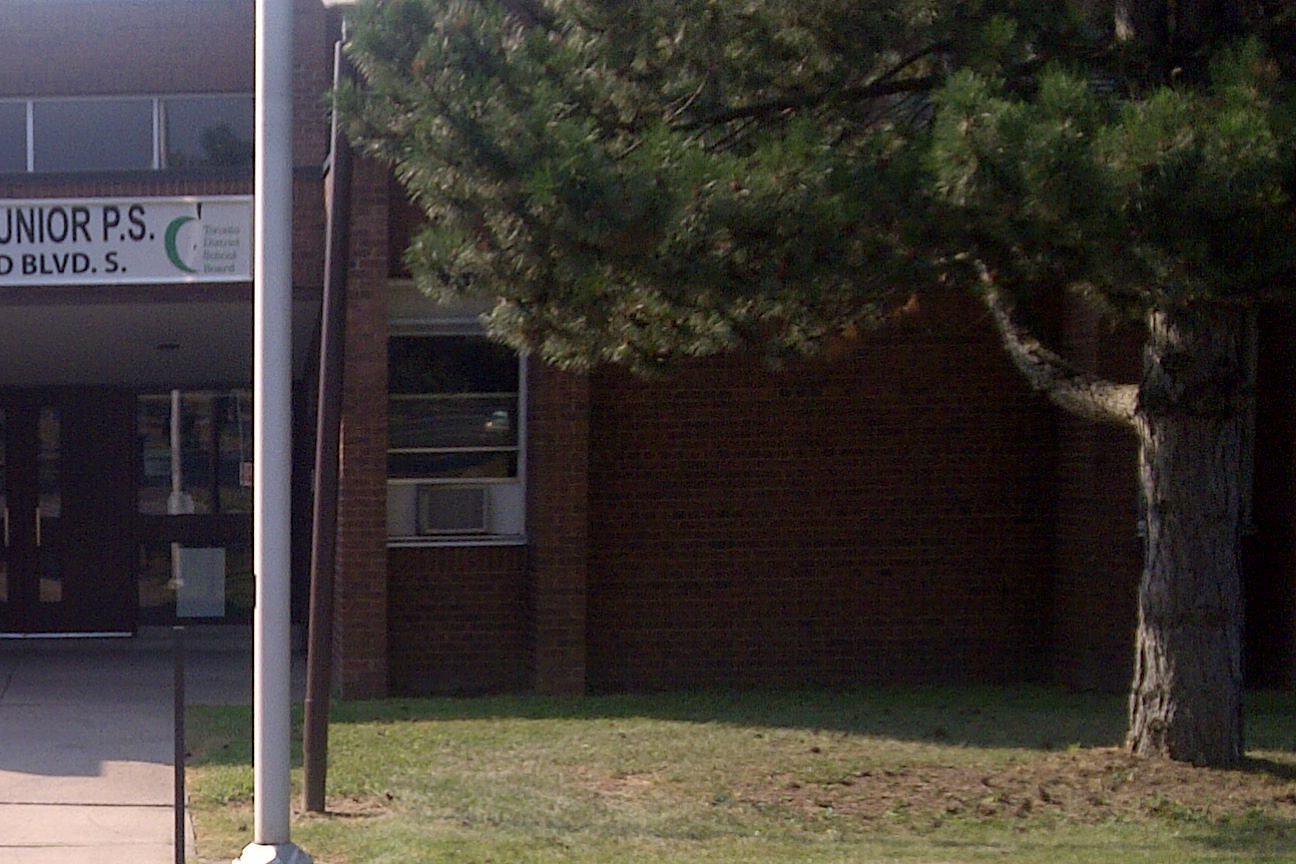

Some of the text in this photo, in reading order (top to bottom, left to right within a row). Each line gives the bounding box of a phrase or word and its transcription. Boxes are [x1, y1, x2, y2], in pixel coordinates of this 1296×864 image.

[102, 206, 155, 242] P.S.
[21, 252, 98, 276] BLVD.
[104, 251, 127, 273] S.
